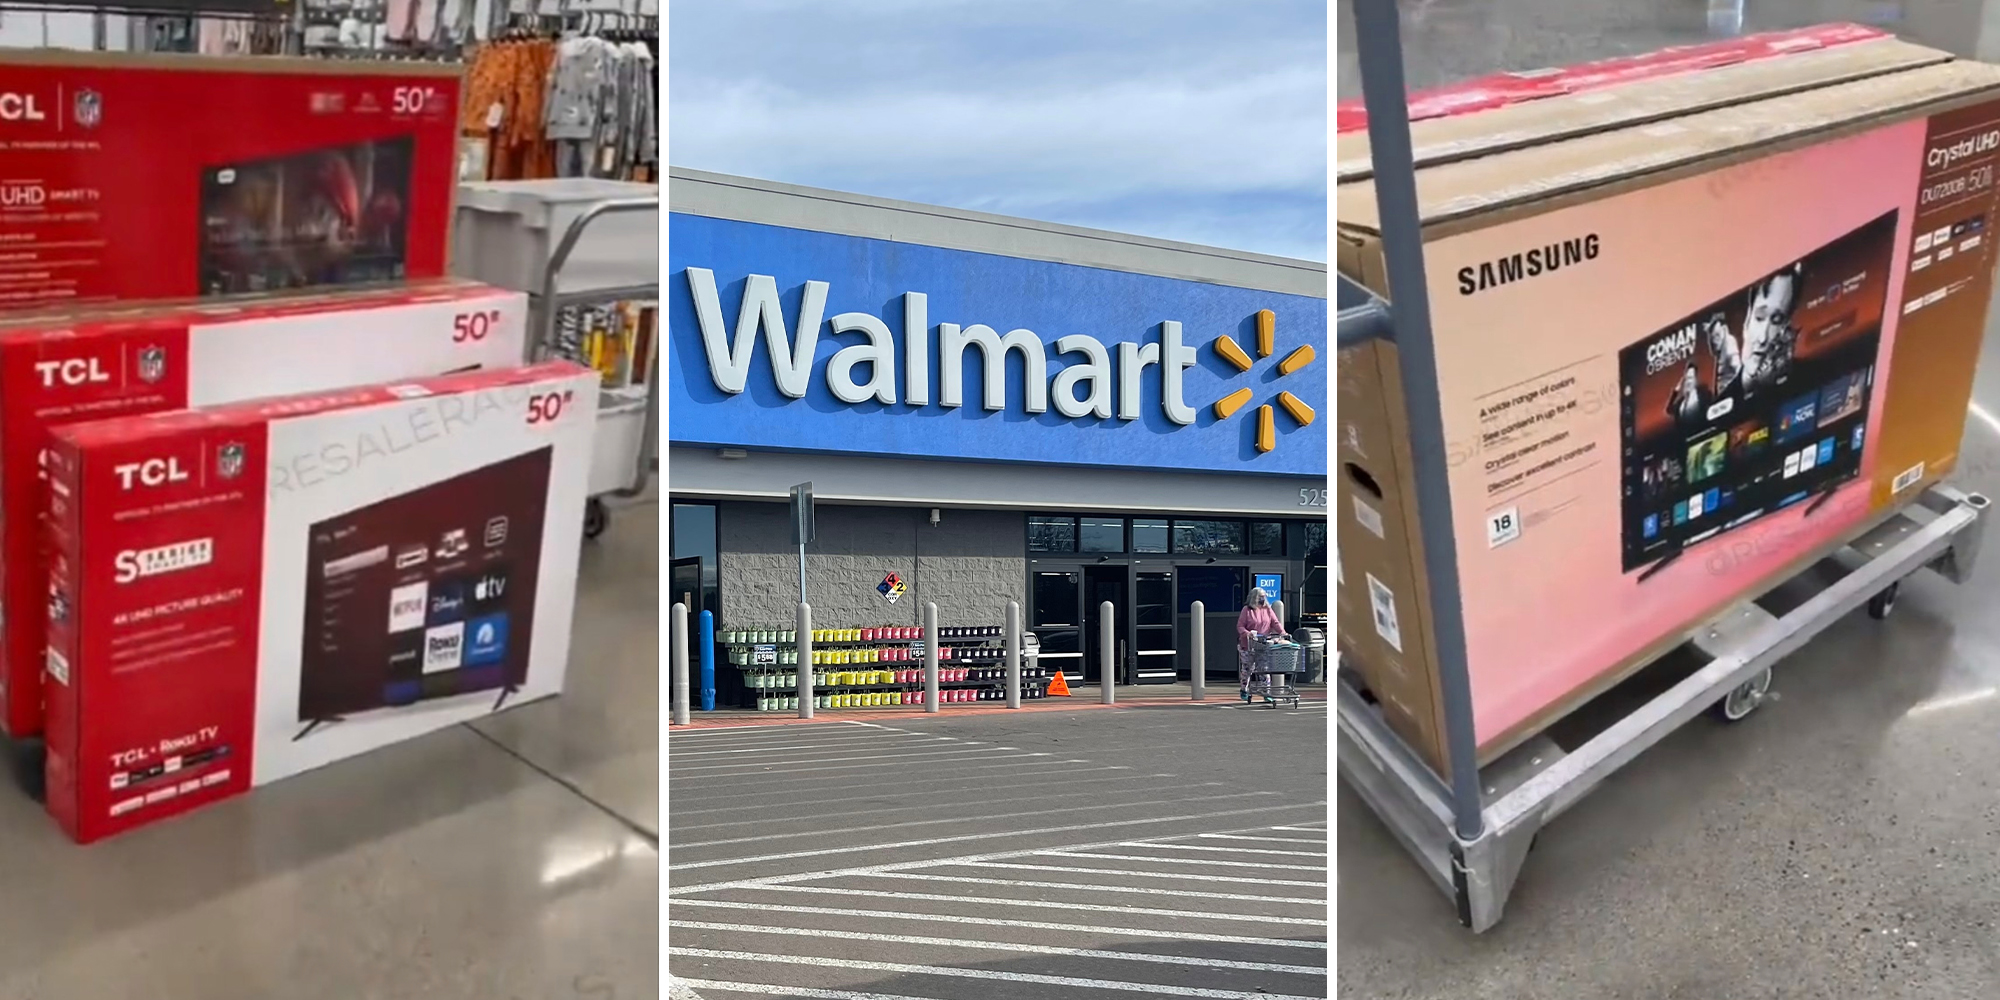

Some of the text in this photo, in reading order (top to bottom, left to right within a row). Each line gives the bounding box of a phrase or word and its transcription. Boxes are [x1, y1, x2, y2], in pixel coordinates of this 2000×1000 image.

[0, 93, 45, 120] CL
[1928, 131, 2000, 170] Crystal UHD
[1458, 232, 1600, 296] SAMSUNG
[686, 266, 1197, 426] Walmart
[1646, 322, 1697, 362] CONAN
[34, 357, 110, 388] TCL
[1479, 377, 1576, 418] A wide range of colors
[1483, 431, 1500, 443] See
[1501, 416, 1535, 436] content
[1485, 431, 1570, 471] Crystal clear motion
[114, 456, 189, 490] TCL
[1487, 471, 1525, 494] Discover
[1526, 454, 1563, 477] excellent
[1299, 488, 1327, 507] 525
[1493, 514, 1512, 533] 18
[115, 549, 138, 583] S
[888, 574, 896, 585] 4
[896, 582, 904, 592] 2
[1260, 579, 1276, 588] EXIT
[110, 748, 148, 768] TCL
[199, 725, 219, 742] TV
